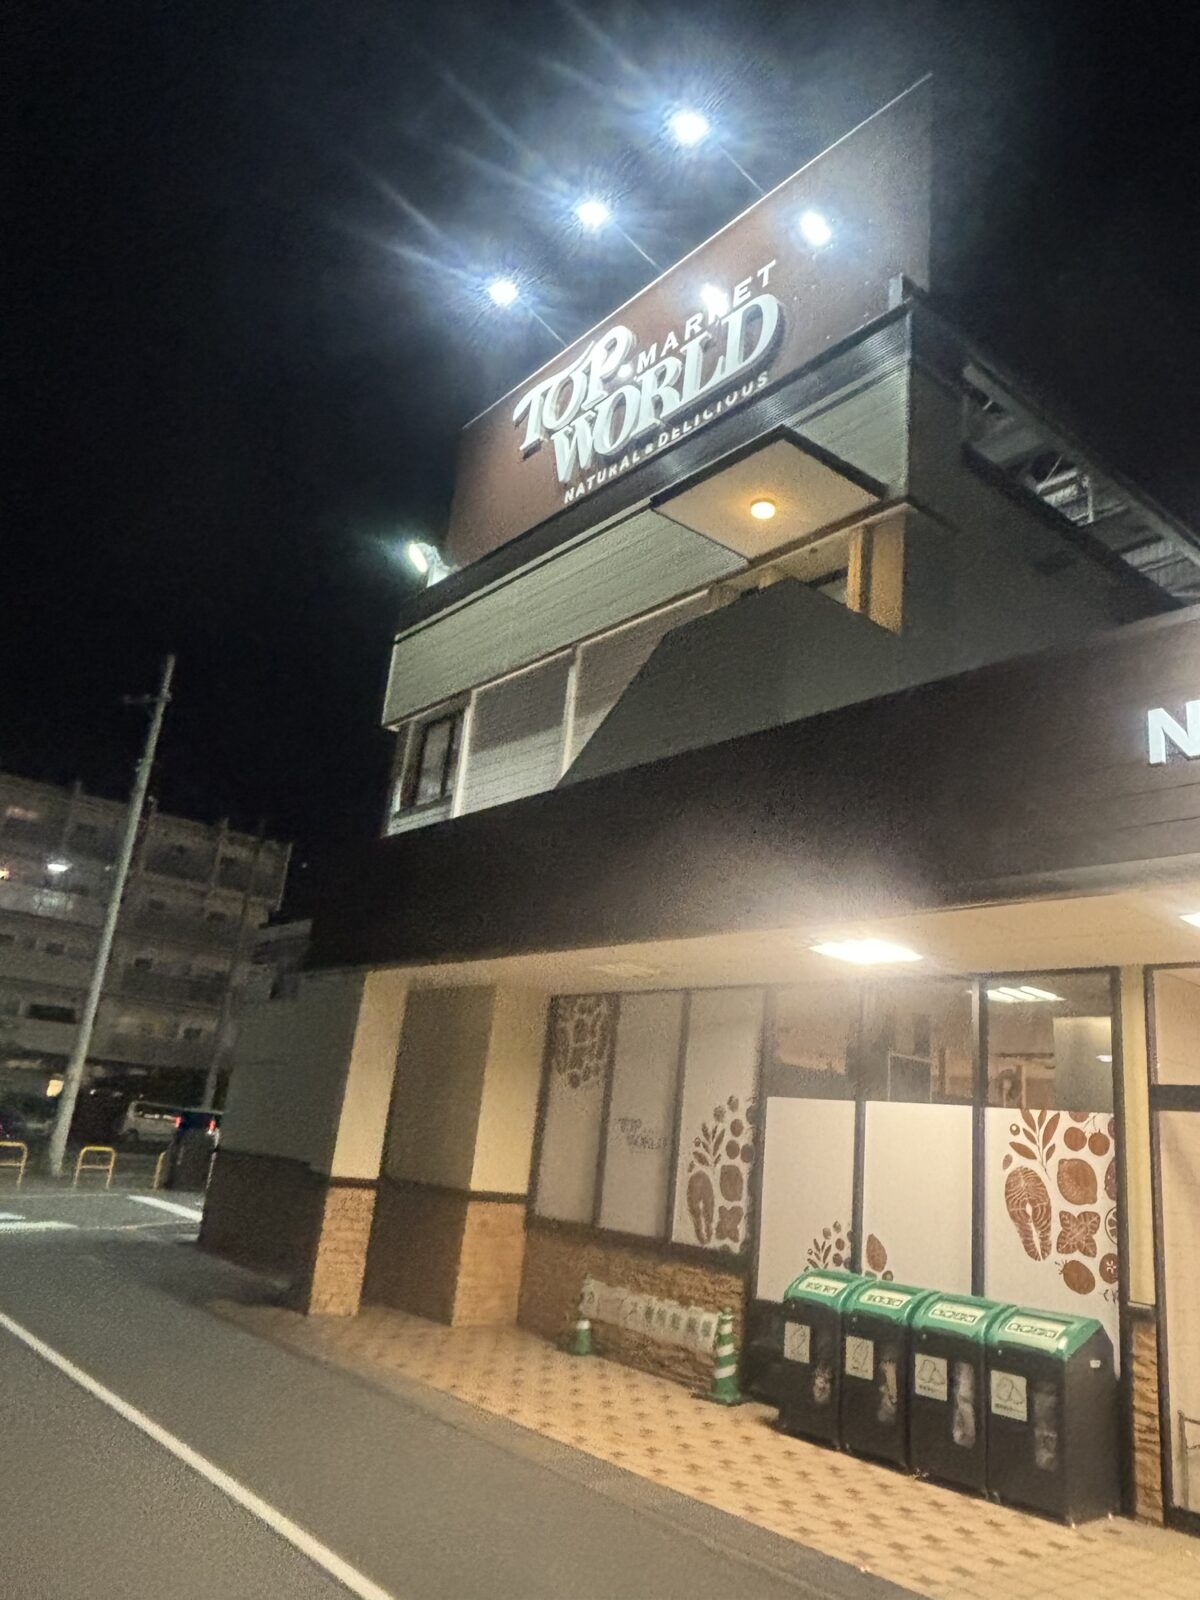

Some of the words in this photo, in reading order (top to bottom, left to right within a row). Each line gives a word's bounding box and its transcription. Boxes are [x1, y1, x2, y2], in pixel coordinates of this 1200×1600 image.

[513, 325, 634, 450] TOP
[550, 293, 779, 482] WORLD
[1148, 700, 1200, 765] N
